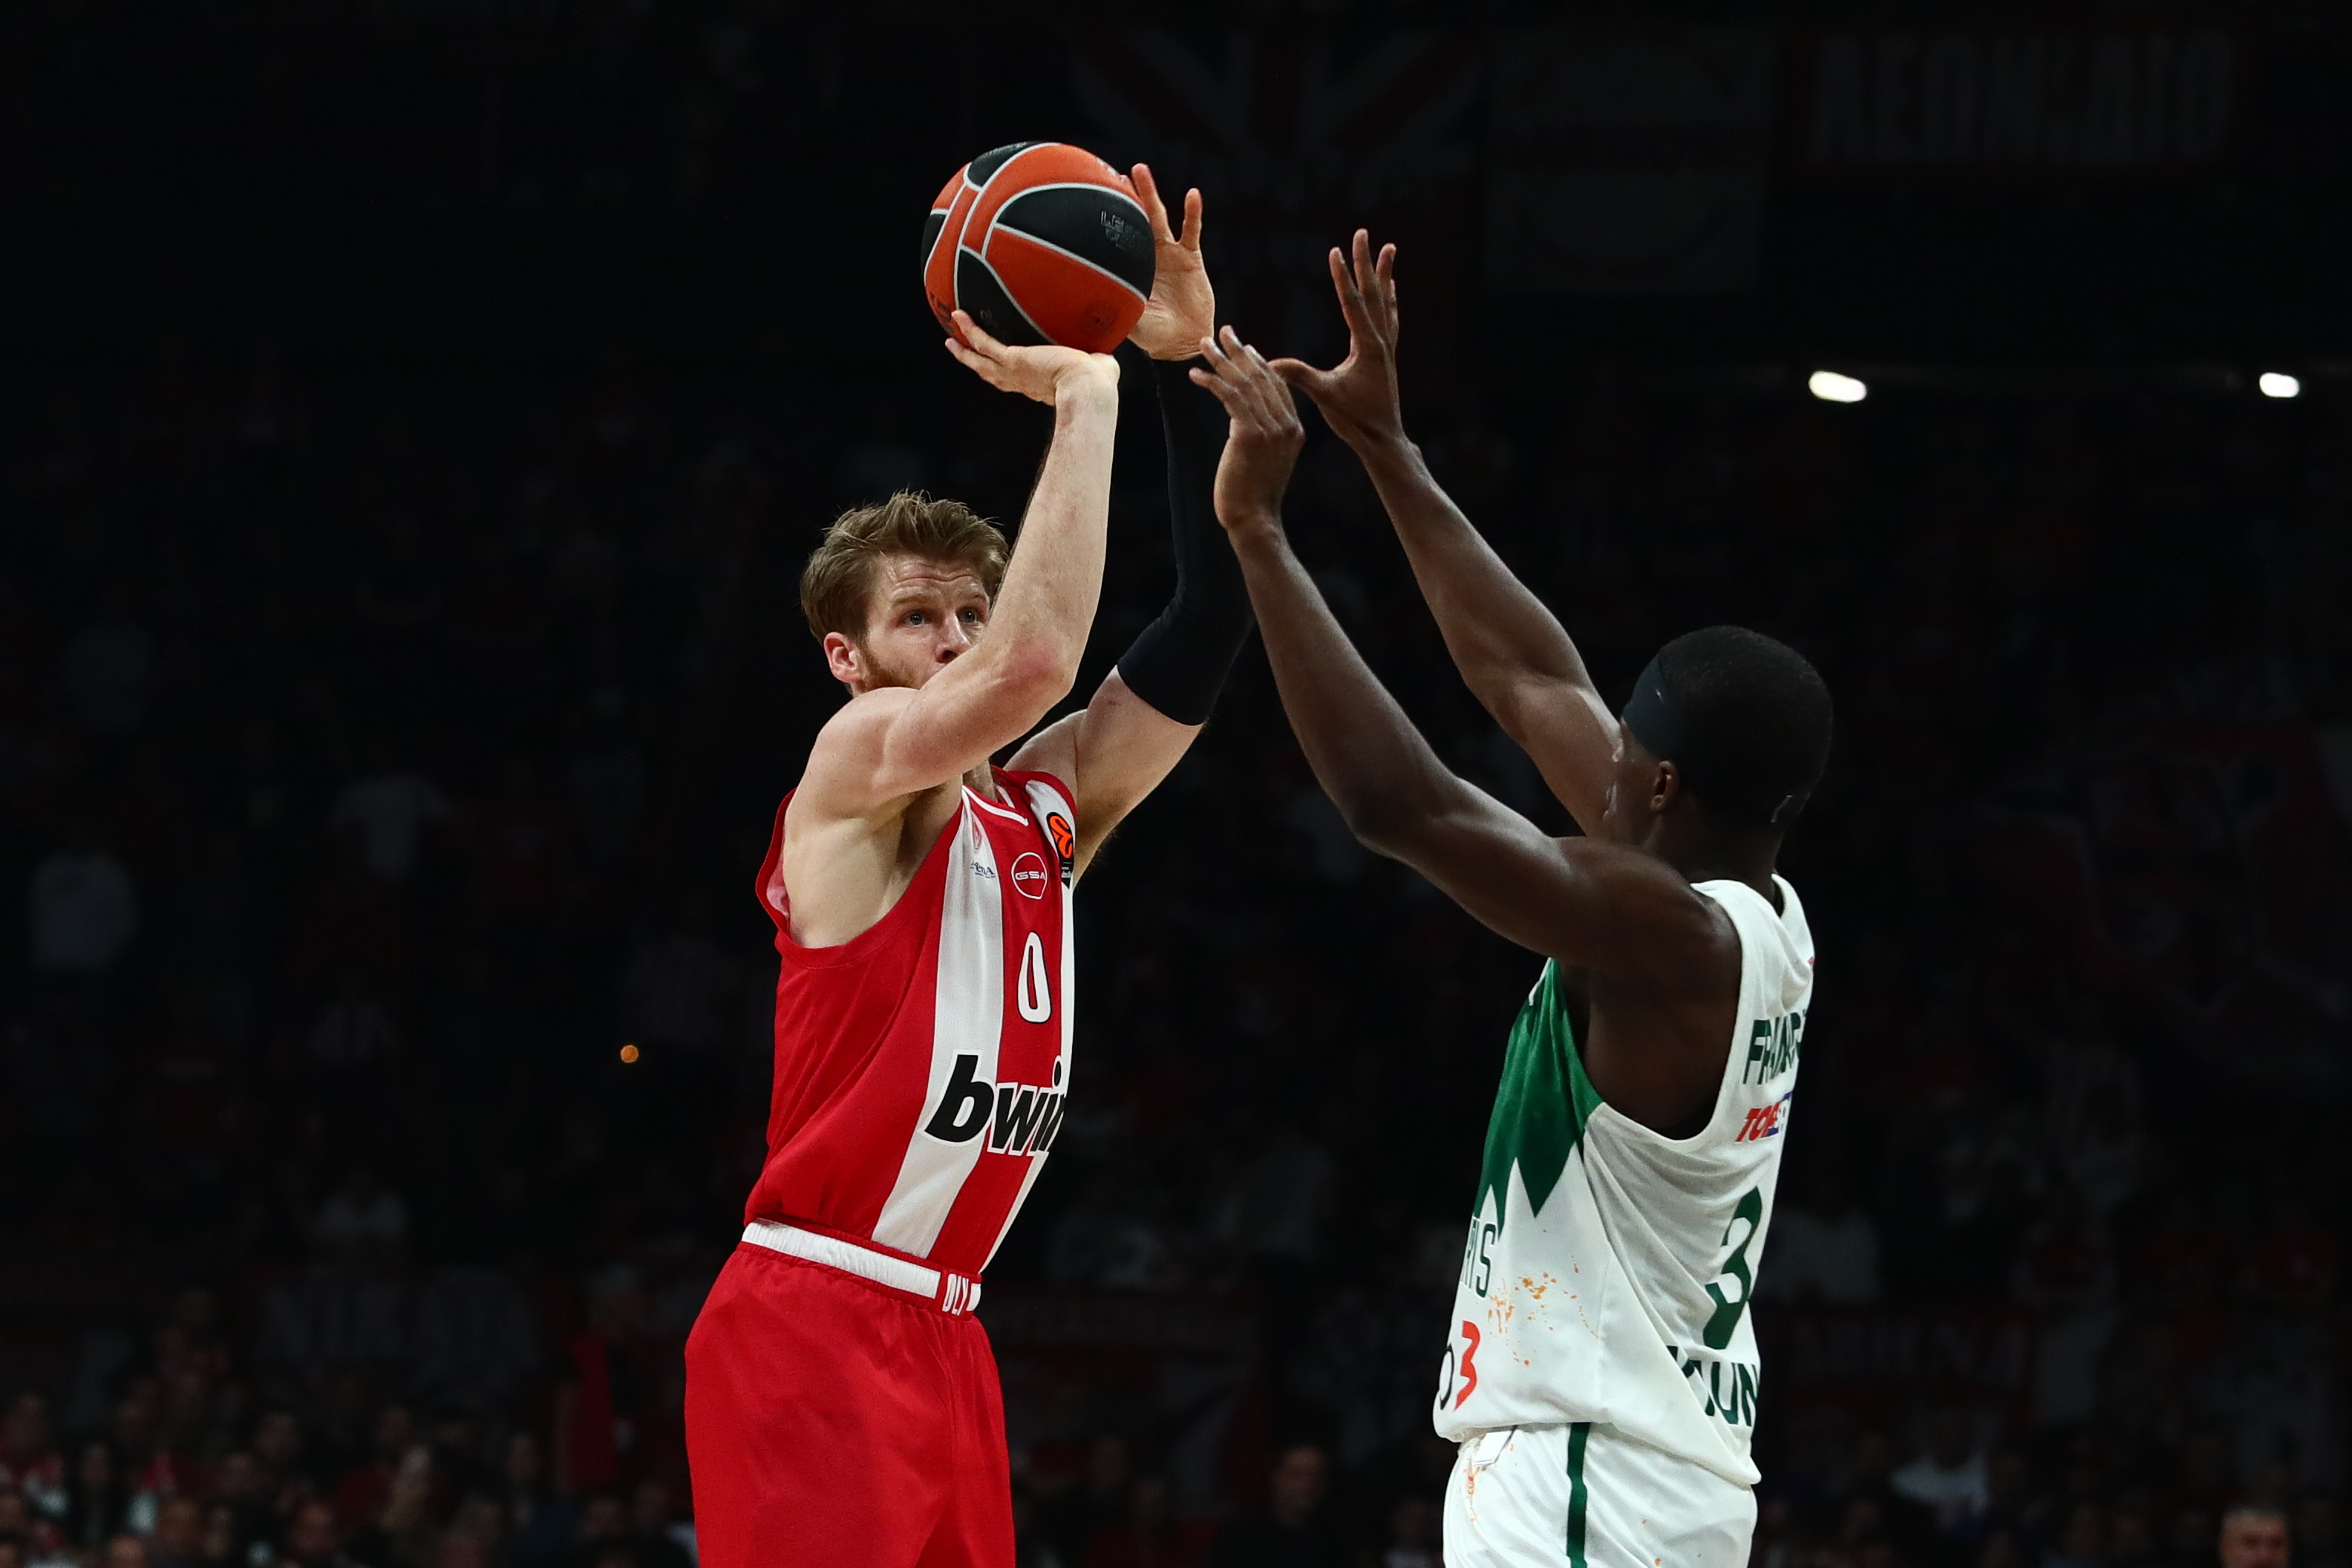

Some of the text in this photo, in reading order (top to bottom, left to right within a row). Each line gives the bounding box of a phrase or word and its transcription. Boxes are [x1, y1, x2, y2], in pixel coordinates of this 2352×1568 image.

[1015, 871, 1045, 881] GSA
[1017, 932, 1051, 1023] 0
[1702, 1186, 1763, 1350] 3
